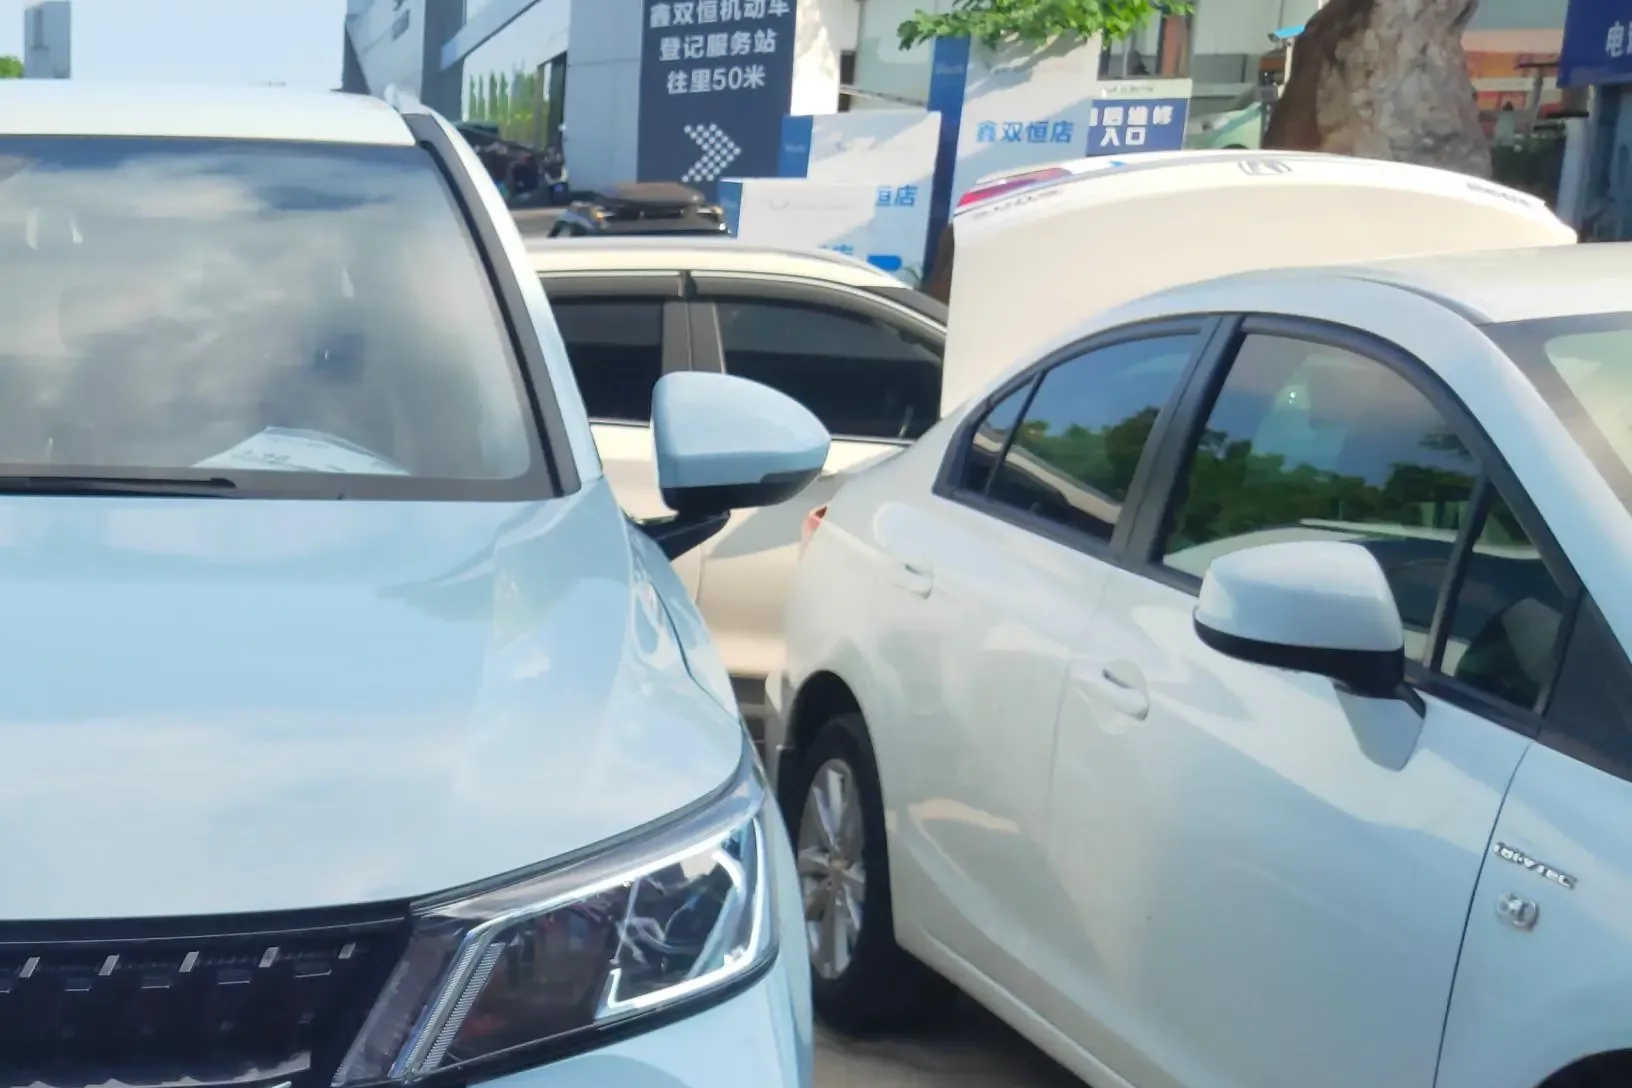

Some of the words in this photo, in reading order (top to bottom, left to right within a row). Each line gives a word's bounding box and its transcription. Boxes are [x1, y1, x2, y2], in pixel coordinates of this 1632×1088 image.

[659, 28, 778, 61] 登记服务站
[1606, 20, 1632, 57] 电
[666, 64, 766, 95] 往里50米
[1099, 126, 1146, 146] 入口
